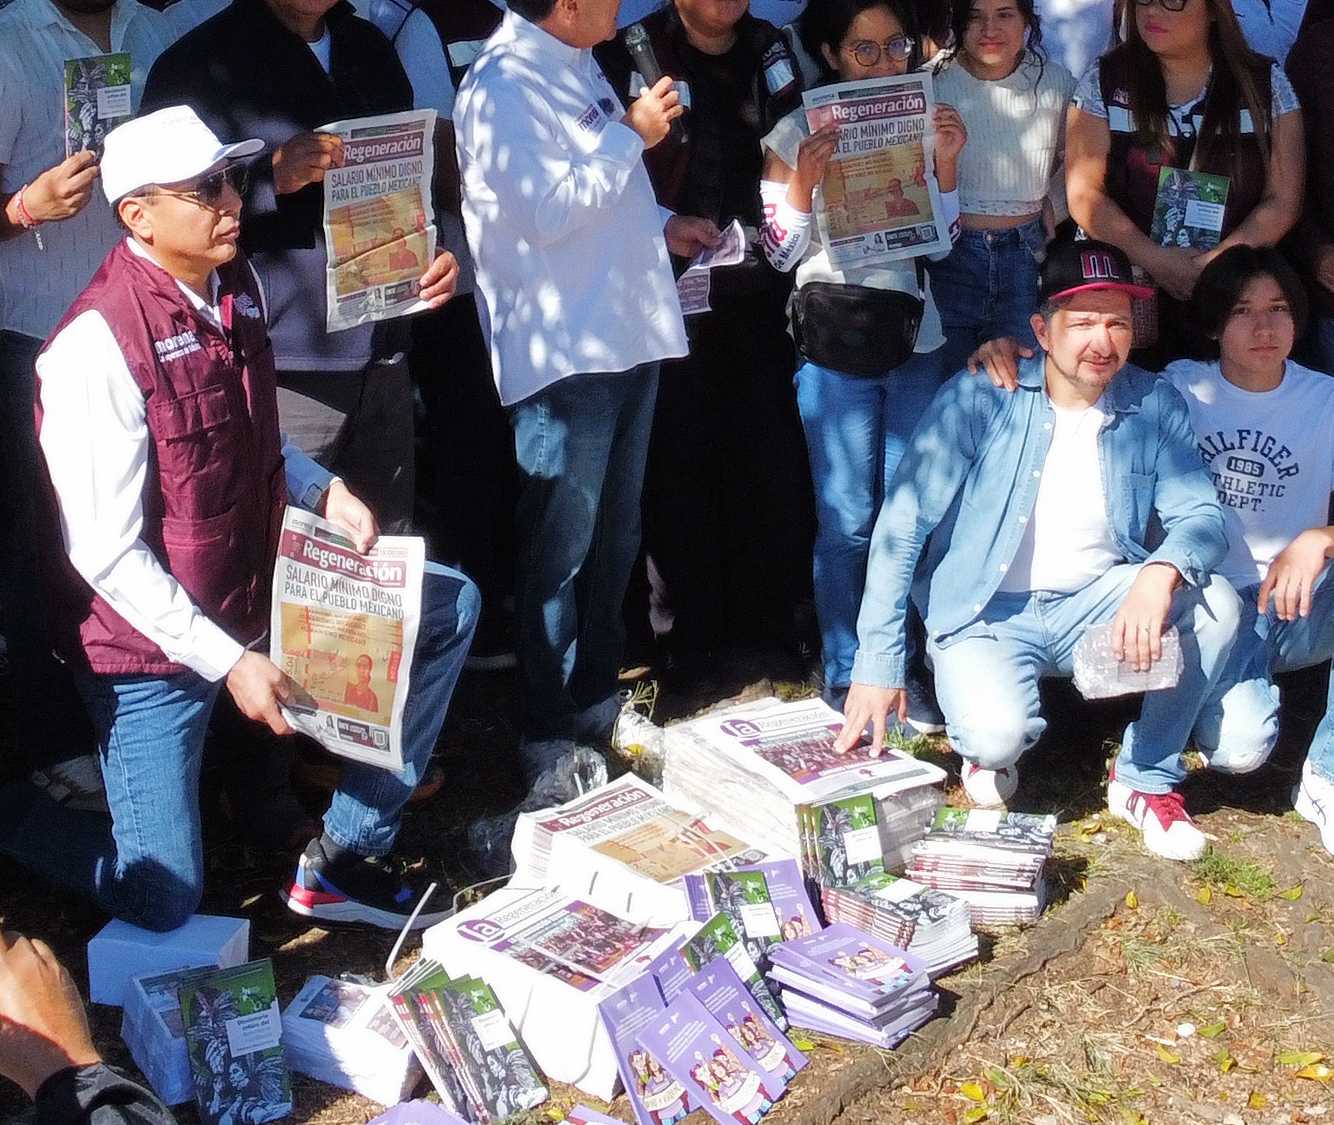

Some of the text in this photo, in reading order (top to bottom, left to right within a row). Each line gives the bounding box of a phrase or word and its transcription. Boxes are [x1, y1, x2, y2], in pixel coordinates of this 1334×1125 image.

[831, 97, 924, 122] Regeneración
[860, 121, 895, 139] MÍNIMO
[897, 117, 926, 133] DIGNO
[343, 135, 422, 163] Regeneración
[841, 143, 852, 154] EL
[853, 138, 884, 153] PUEBLO
[331, 159, 423, 189] SALARIO MÍNIMO DIGNO
[331, 187, 350, 203] PARA
[350, 186, 359, 199] EL
[360, 181, 386, 197] PUEBLO
[154, 329, 198, 355] morena
[1228, 457, 1261, 477] 1985
[1211, 471, 1287, 498] THLETIC
[302, 539, 403, 582] Regeneración
[285, 563, 403, 608] SALARIO MÍNIMO DIGNO
[284, 582, 308, 601] PARA
[322, 590, 358, 611] PUEBLO
[359, 599, 405, 621] MEXICANO
[557, 788, 647, 827] Regeneración
